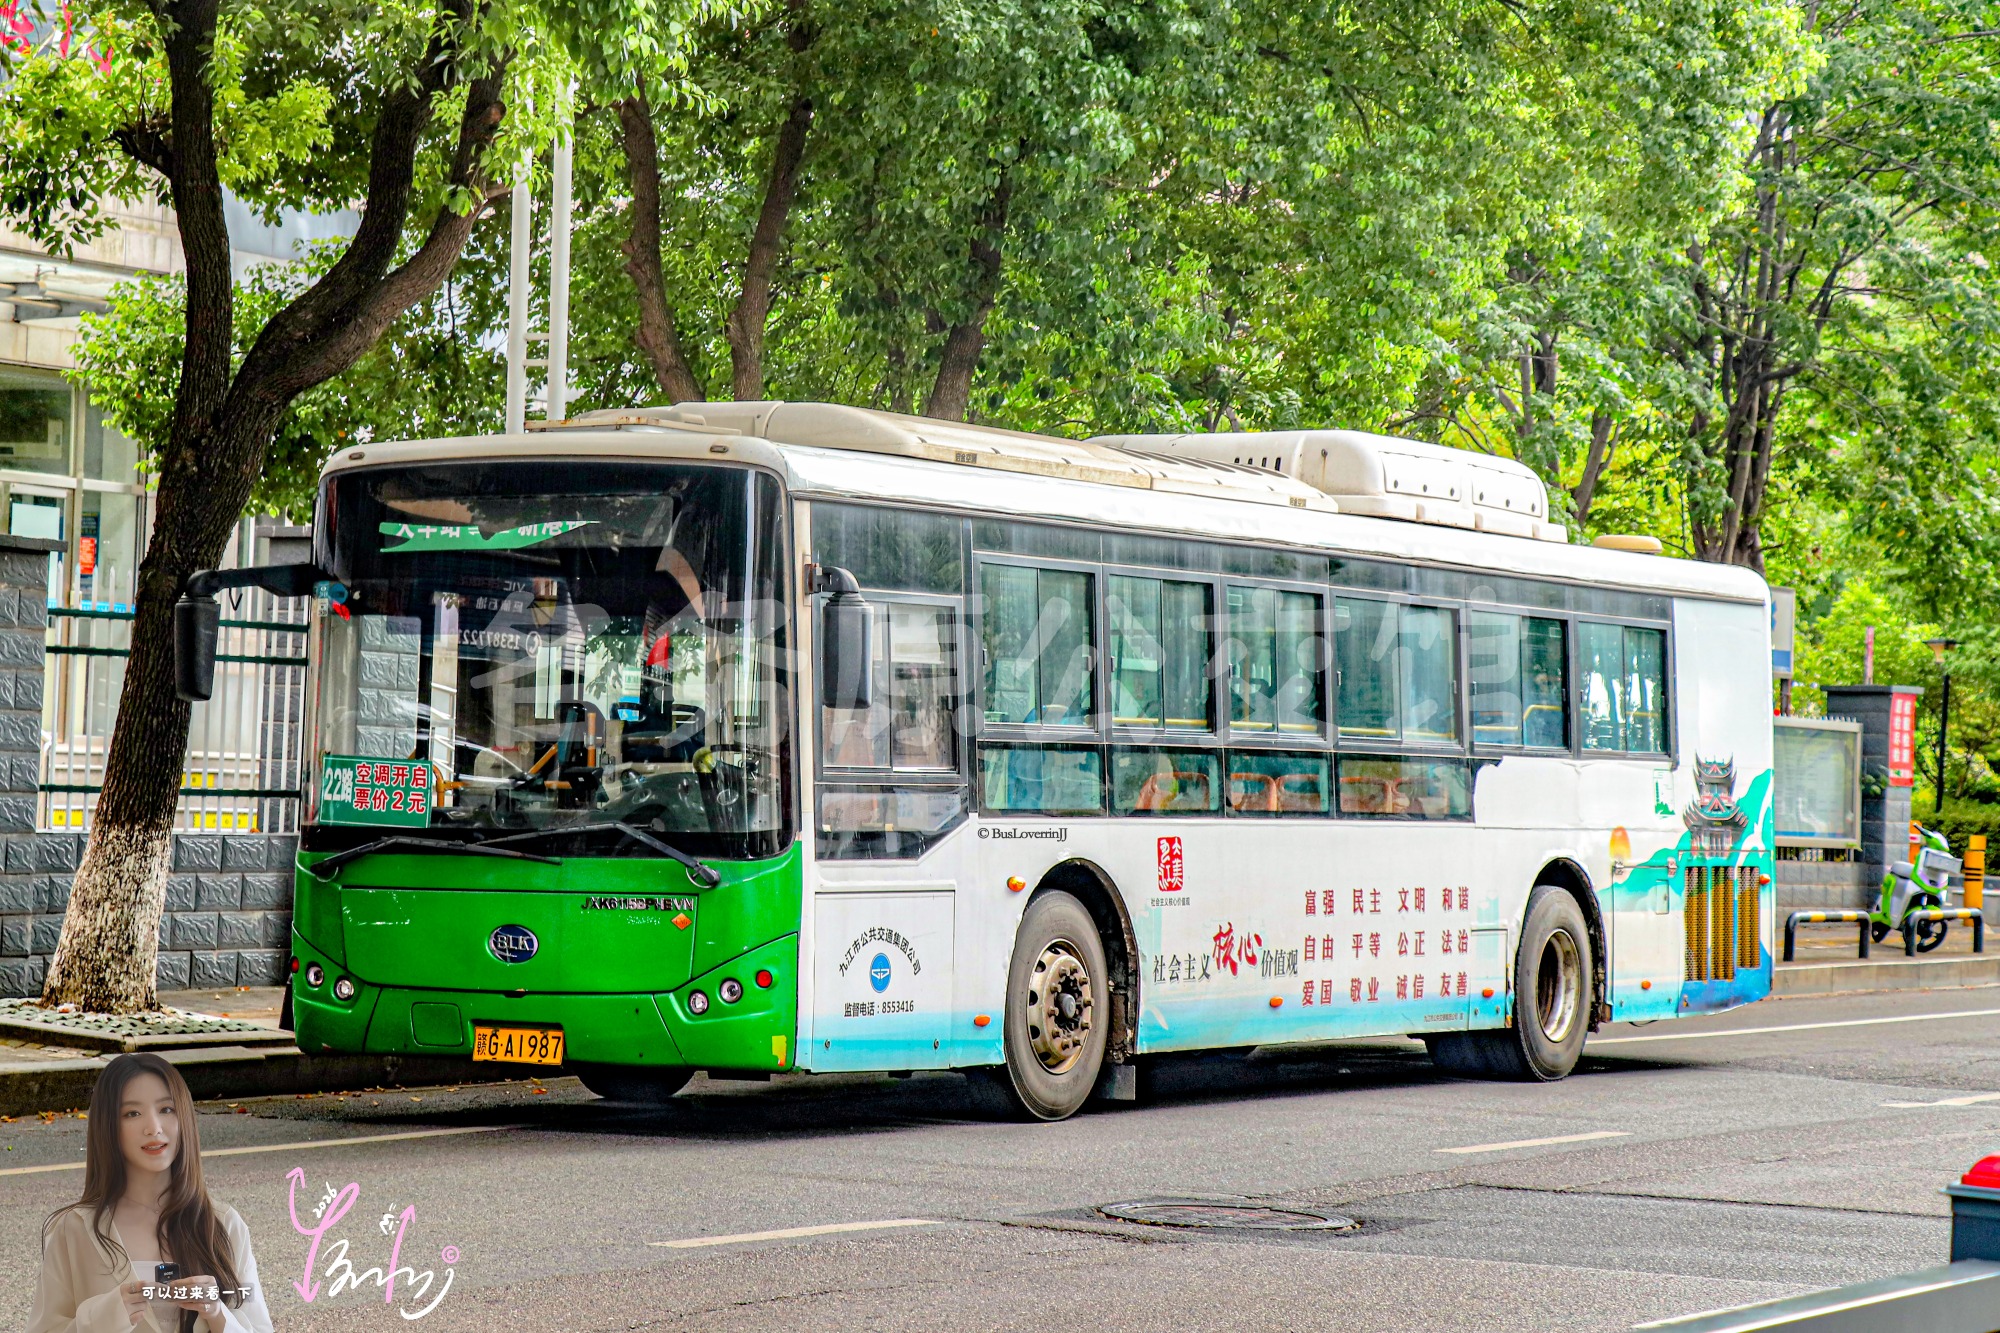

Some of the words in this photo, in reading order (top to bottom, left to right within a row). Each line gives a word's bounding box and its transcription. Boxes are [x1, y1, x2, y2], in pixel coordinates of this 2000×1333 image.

[323, 767, 353, 803] 22路
[355, 762, 428, 788] 空调开启
[353, 788, 426, 814] 票价2元
[1151, 897, 1190, 906] 社会主义核心价值观
[1305, 889, 1335, 915] 富强
[1353, 888, 1381, 914] 民主
[1398, 887, 1426, 912] 文明
[1442, 886, 1469, 911] 和谐
[497, 934, 531, 951] BLK
[839, 926, 922, 978] 九江市公共交通集团公司
[1304, 934, 1334, 961] 自由
[1352, 932, 1381, 958] 平等
[1397, 931, 1426, 956] 公正
[1441, 929, 1469, 954] 法治
[1302, 979, 1333, 1006] 爱国
[1350, 977, 1379, 1002] 敬业
[1397, 973, 1425, 1000] 诚信
[1440, 971, 1468, 997] 友善
